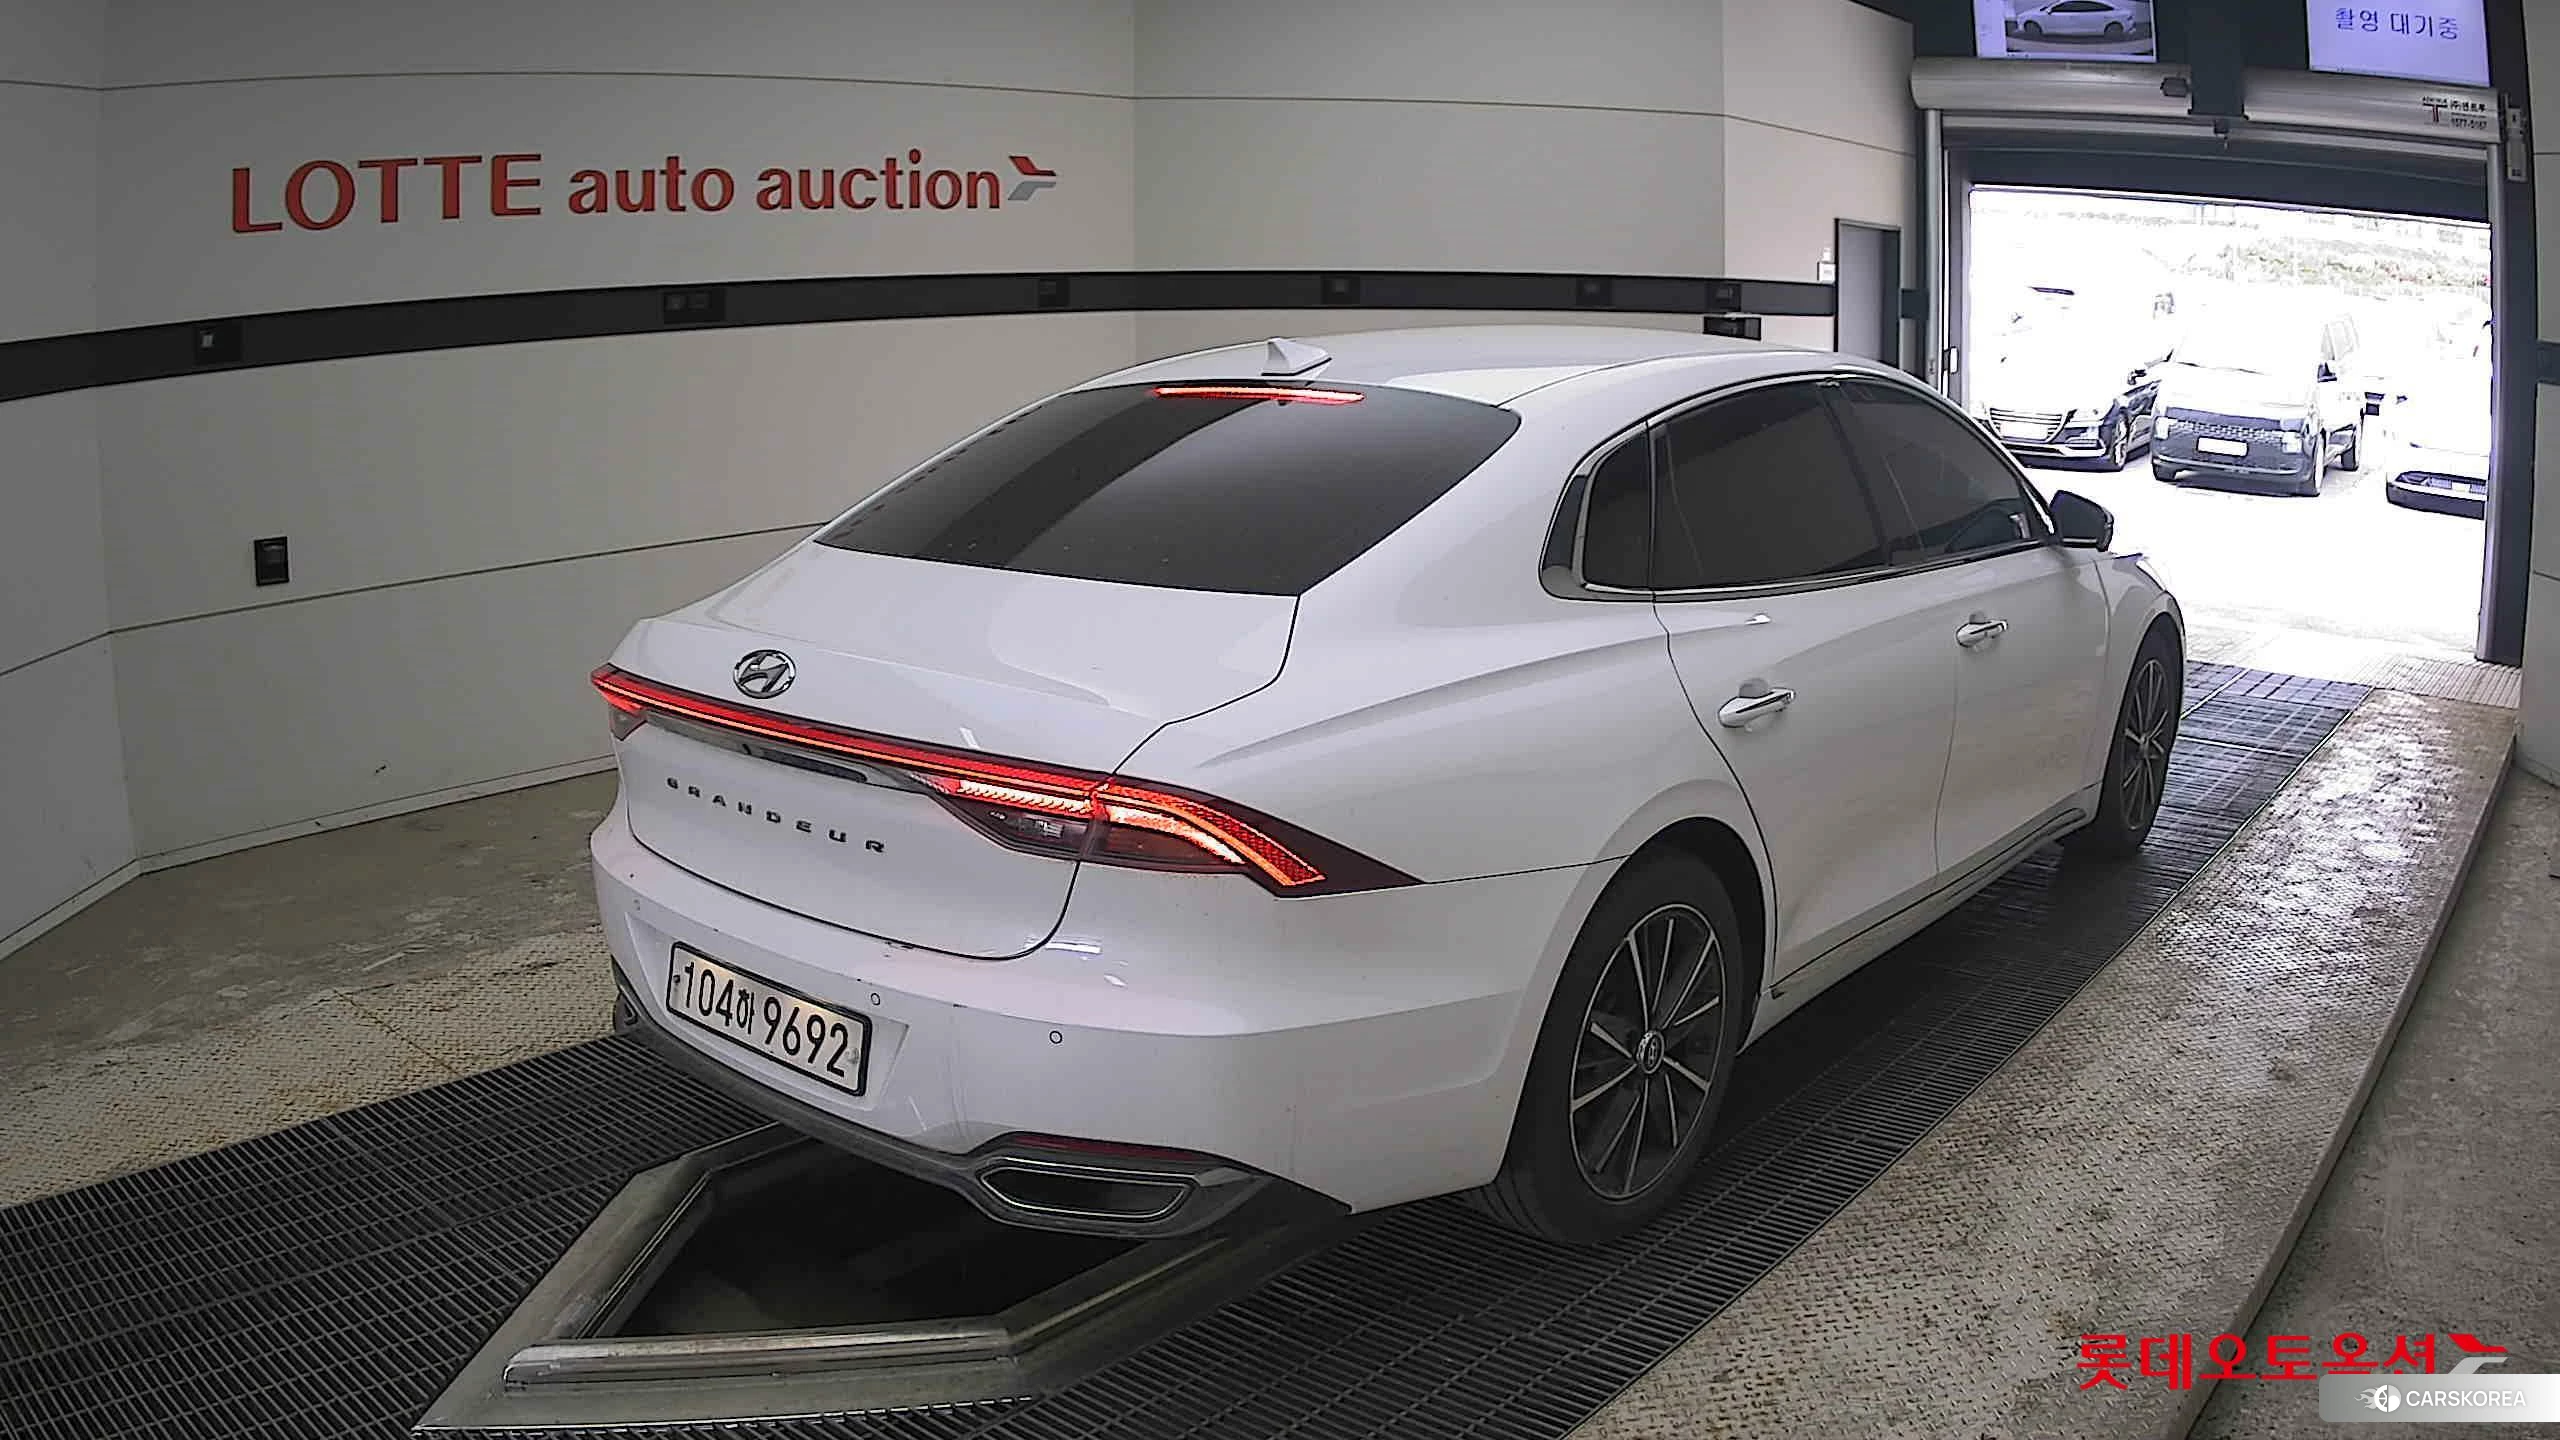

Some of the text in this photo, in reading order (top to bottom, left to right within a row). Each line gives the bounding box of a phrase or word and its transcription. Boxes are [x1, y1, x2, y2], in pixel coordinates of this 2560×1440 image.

[2335, 8, 2379, 32] 촬영
[232, 148, 1001, 233] LOTTE auto auction
[666, 776, 887, 854] GRANDEUR
[763, 996, 849, 1078] 9692
